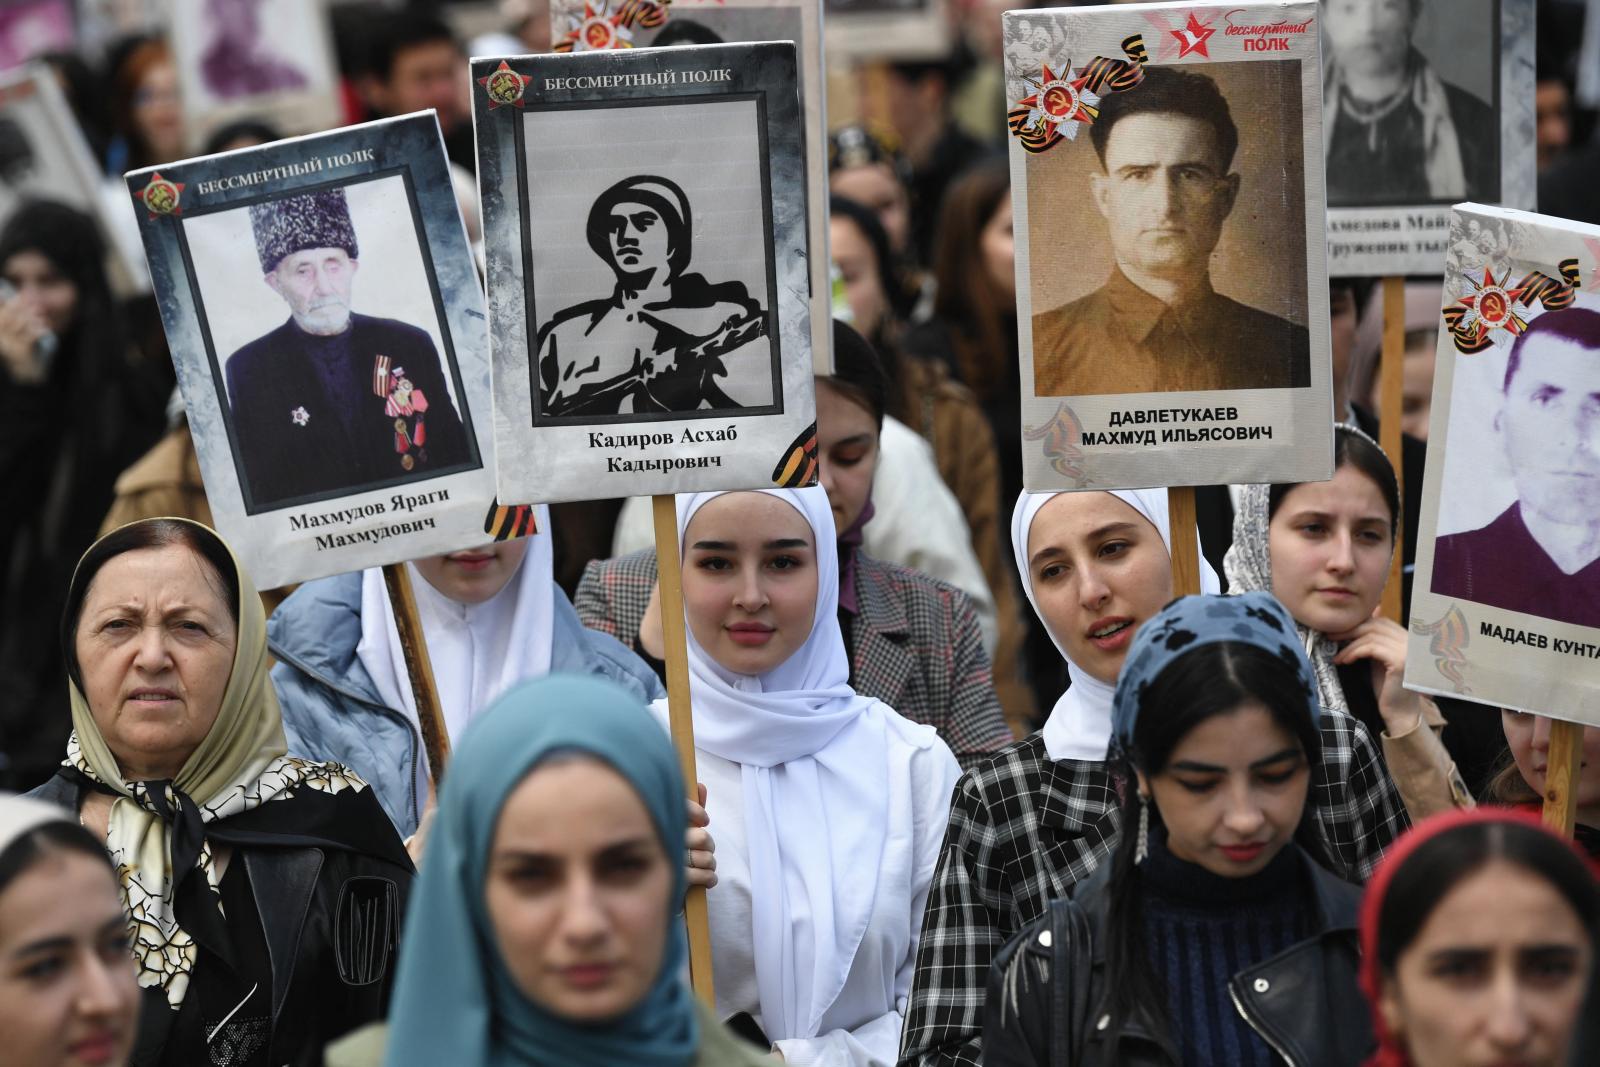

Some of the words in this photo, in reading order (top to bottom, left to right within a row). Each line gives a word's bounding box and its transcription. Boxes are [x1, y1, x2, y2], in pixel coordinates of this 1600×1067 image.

[1243, 37, 1290, 52] ПОЛК
[544, 69, 676, 91] БЕССМЕРТНЫЙ
[681, 68, 732, 84] ПОЛК
[197, 156, 323, 195] БЕССМЕРТНЫЙ
[327, 148, 376, 169] ПОЛК
[1108, 407, 1239, 428] ДАВЛЕТУКАЕВ
[588, 432, 674, 450] Кадиров
[680, 425, 738, 444] Асхаб
[1081, 429, 1157, 446] МАХМУД
[1161, 426, 1273, 442] ИЛЬЯСОВИЧ
[606, 455, 722, 474] Кадырович
[289, 502, 386, 532] Махмудов
[390, 488, 450, 512] Яраги
[314, 517, 437, 551] Махмудович
[1480, 621, 1548, 649] МАДАЕВ
